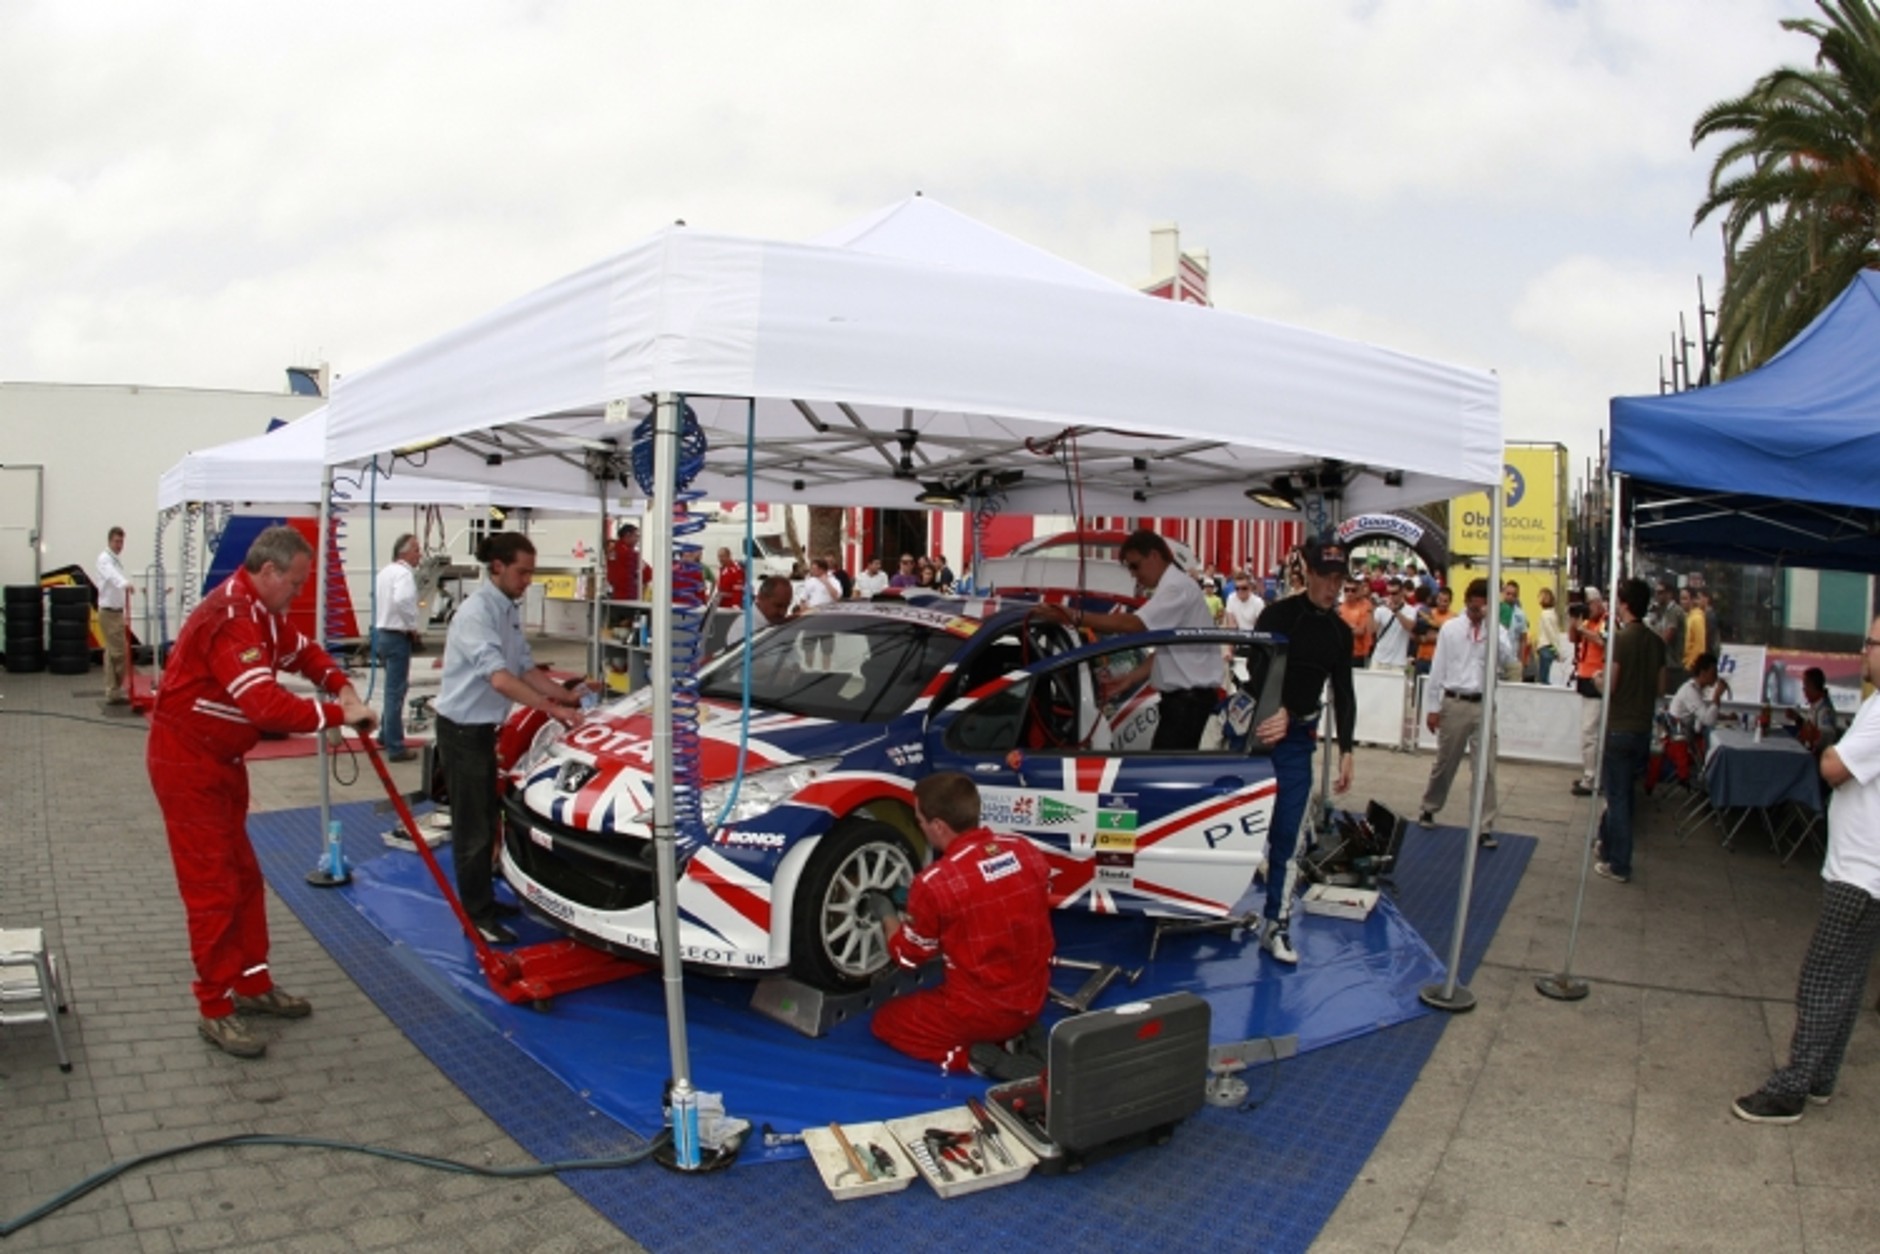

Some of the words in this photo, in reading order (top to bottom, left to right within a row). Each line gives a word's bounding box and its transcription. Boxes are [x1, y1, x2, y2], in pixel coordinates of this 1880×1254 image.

[1501, 516, 1546, 530] SOCIAL
[573, 724, 653, 765] OTA
[1203, 810, 1268, 849] PE
[745, 955, 766, 966] UK
